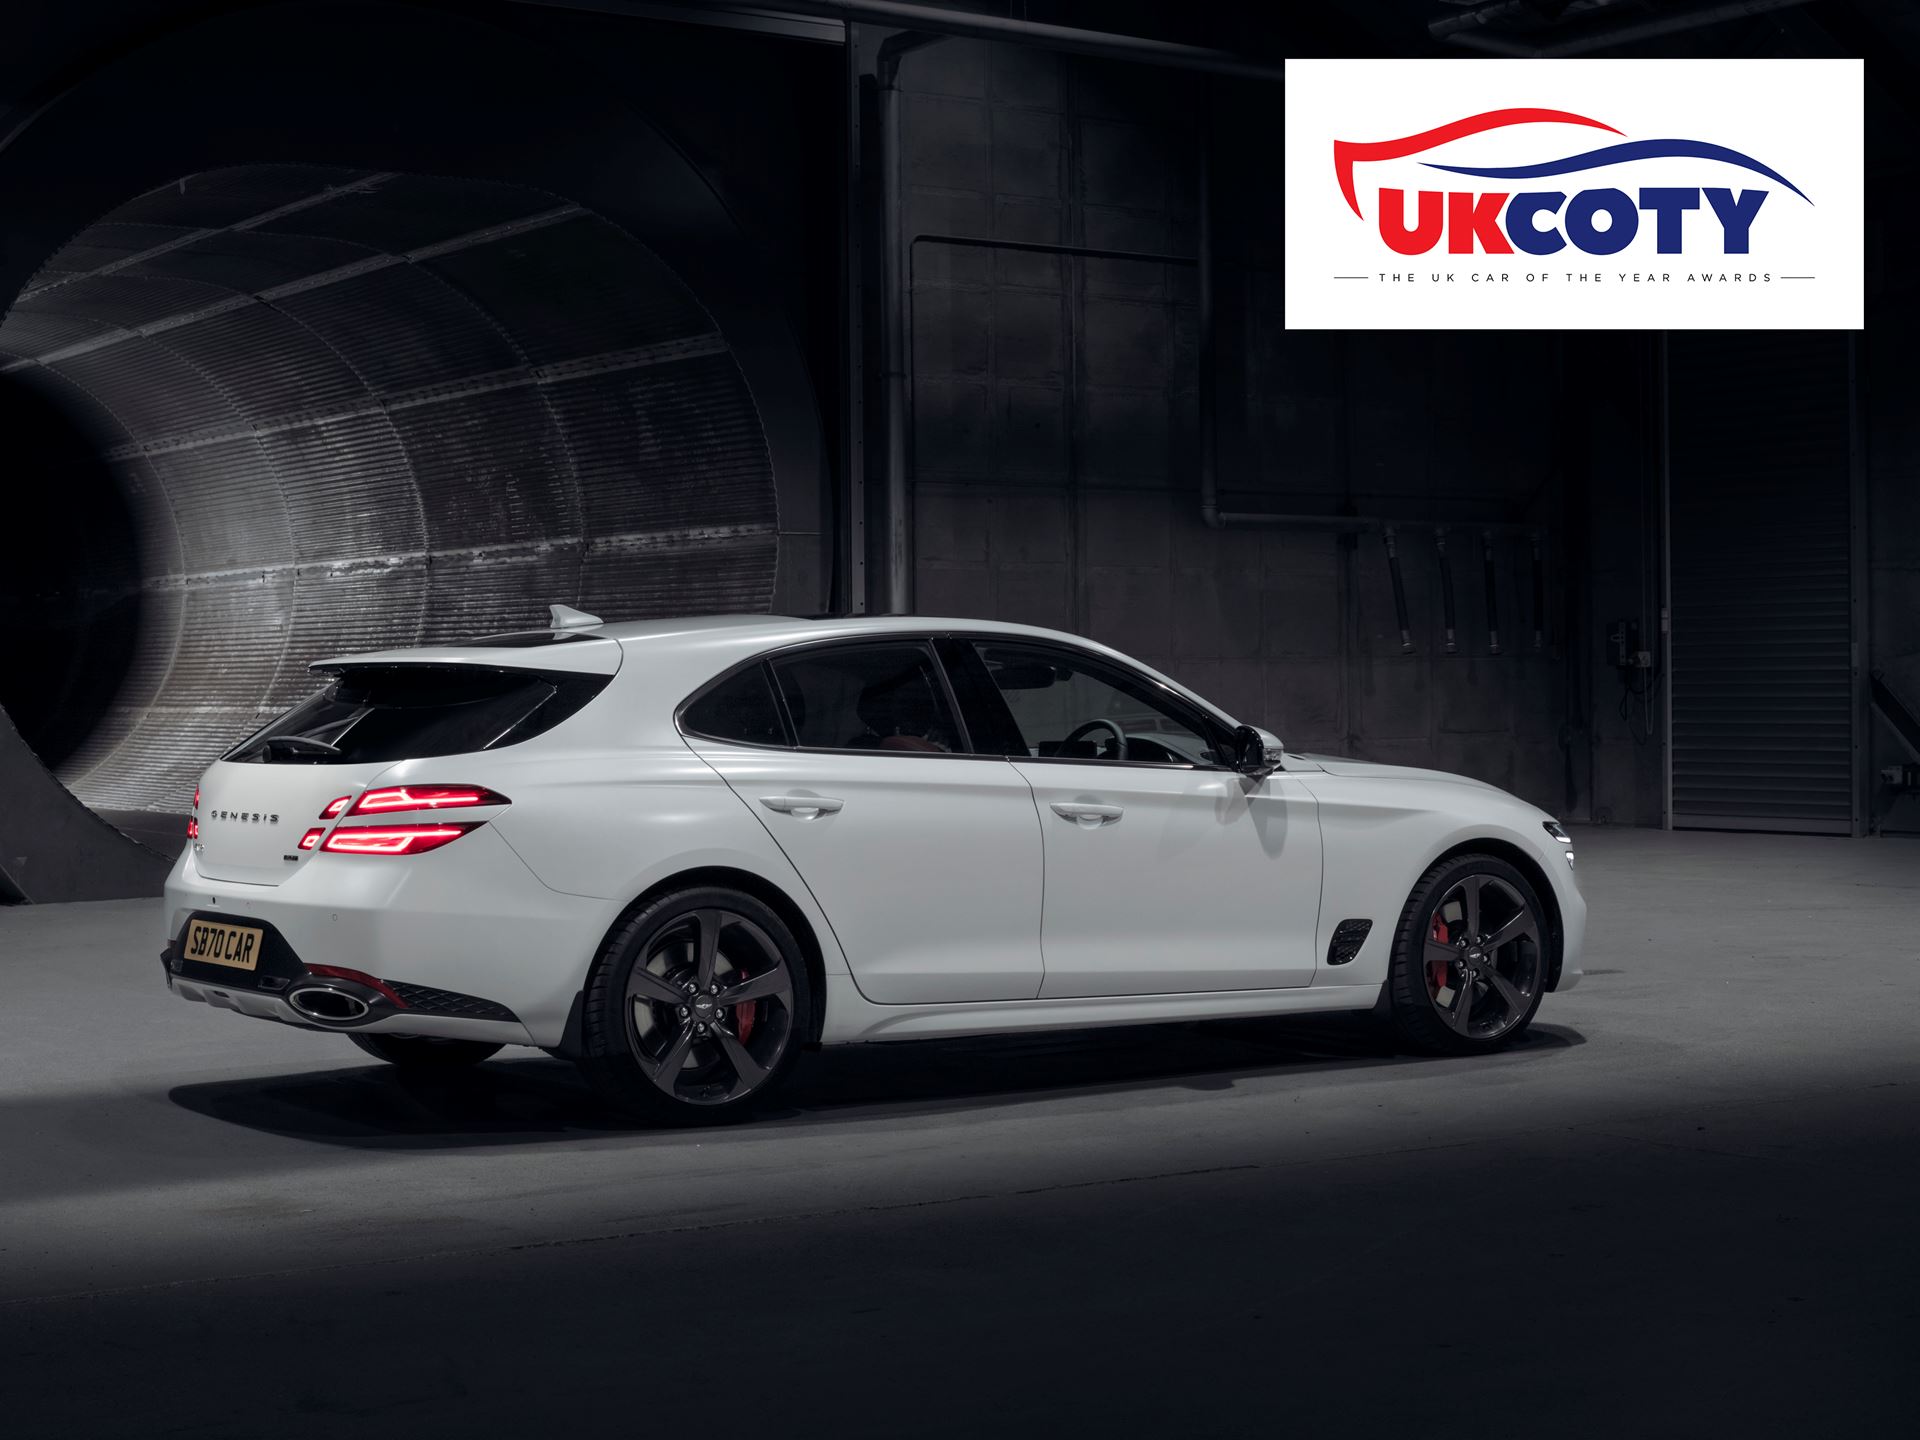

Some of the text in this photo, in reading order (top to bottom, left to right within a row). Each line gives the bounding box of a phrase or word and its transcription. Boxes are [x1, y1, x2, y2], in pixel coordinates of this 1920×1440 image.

[211, 809, 280, 824] GENESIS
[190, 925, 255, 963] SB70 CAR
